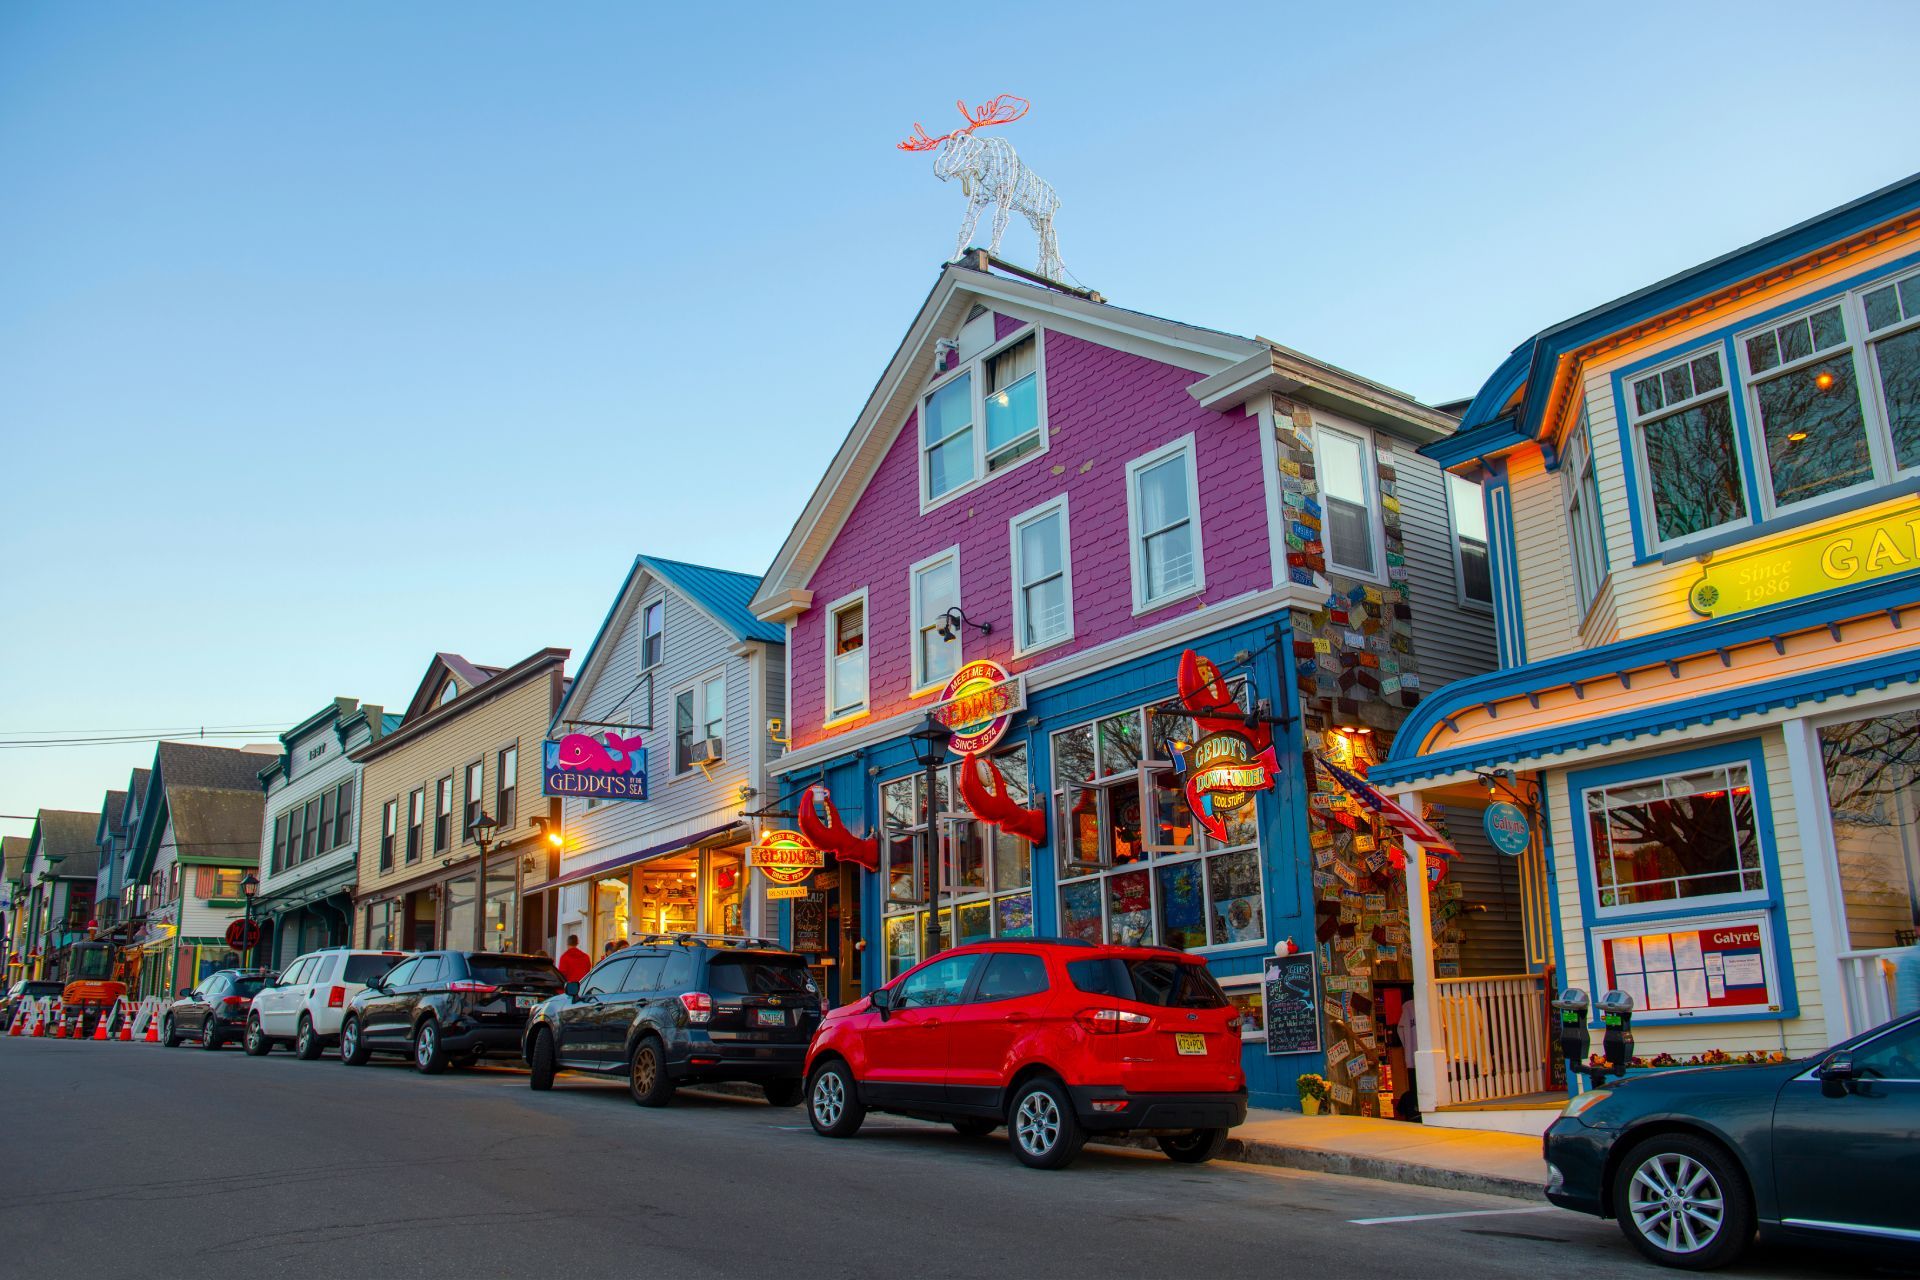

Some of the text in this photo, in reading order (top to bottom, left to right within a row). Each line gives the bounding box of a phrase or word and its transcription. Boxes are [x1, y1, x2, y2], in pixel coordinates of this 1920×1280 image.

[1738, 559, 1792, 585] Since
[1744, 575, 1790, 603] 1986
[950, 667, 997, 691] MEET ME AT
[935, 686, 1009, 727] GEDDY'S
[954, 727, 997, 750] SINCE 1974
[1195, 736, 1248, 768] GEDDY'S
[550, 773, 626, 794] GEDDY'S
[629, 784, 643, 795] SEA
[1214, 796, 1227, 808] COOL
[770, 834, 785, 844] MEET
[759, 849, 816, 864] GEDDY'S
[772, 872, 789, 880] SINCE
[1713, 932, 1760, 945] Galyn's
